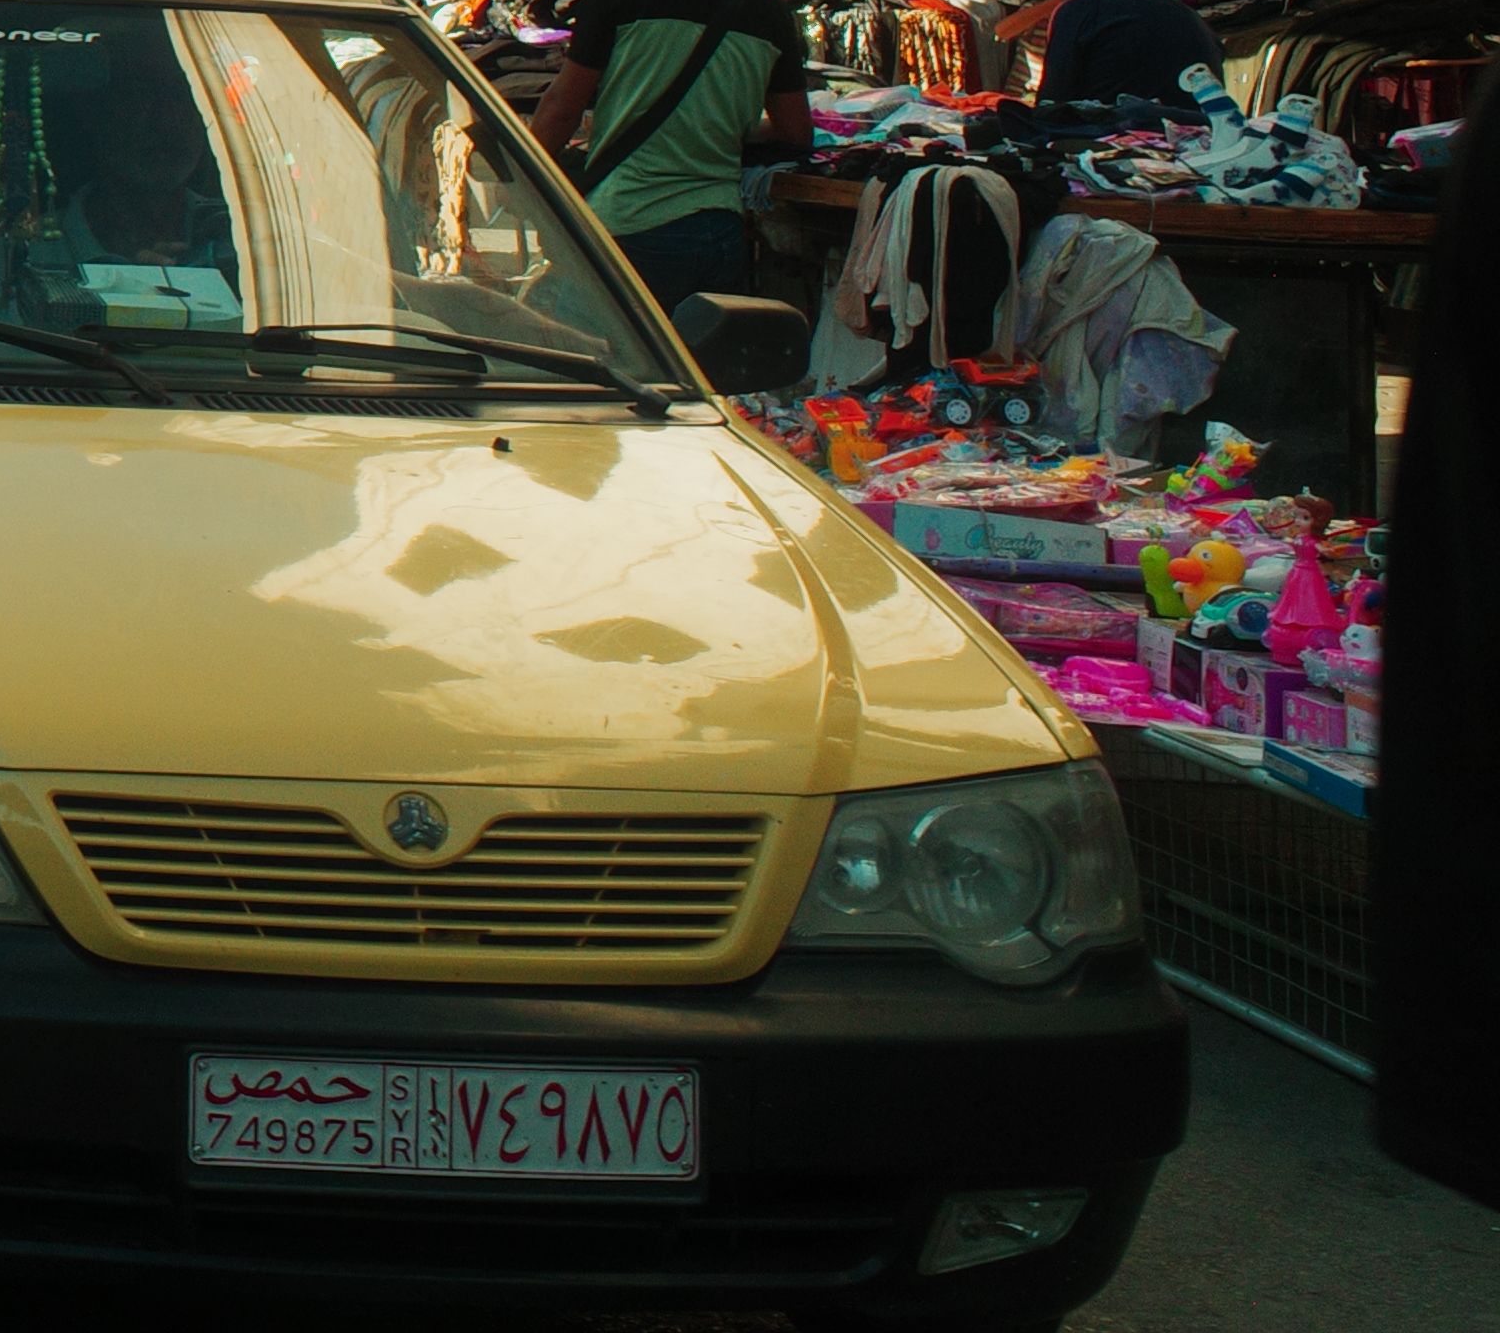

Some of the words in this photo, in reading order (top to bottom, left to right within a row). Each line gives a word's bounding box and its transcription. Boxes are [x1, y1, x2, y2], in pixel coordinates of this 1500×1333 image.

[203, 1070, 372, 1104] حمص
[390, 1075, 411, 1162] SYR
[206, 1112, 375, 1156] 749875
[457, 1080, 689, 1164] ٧٤٩٨٧٥
